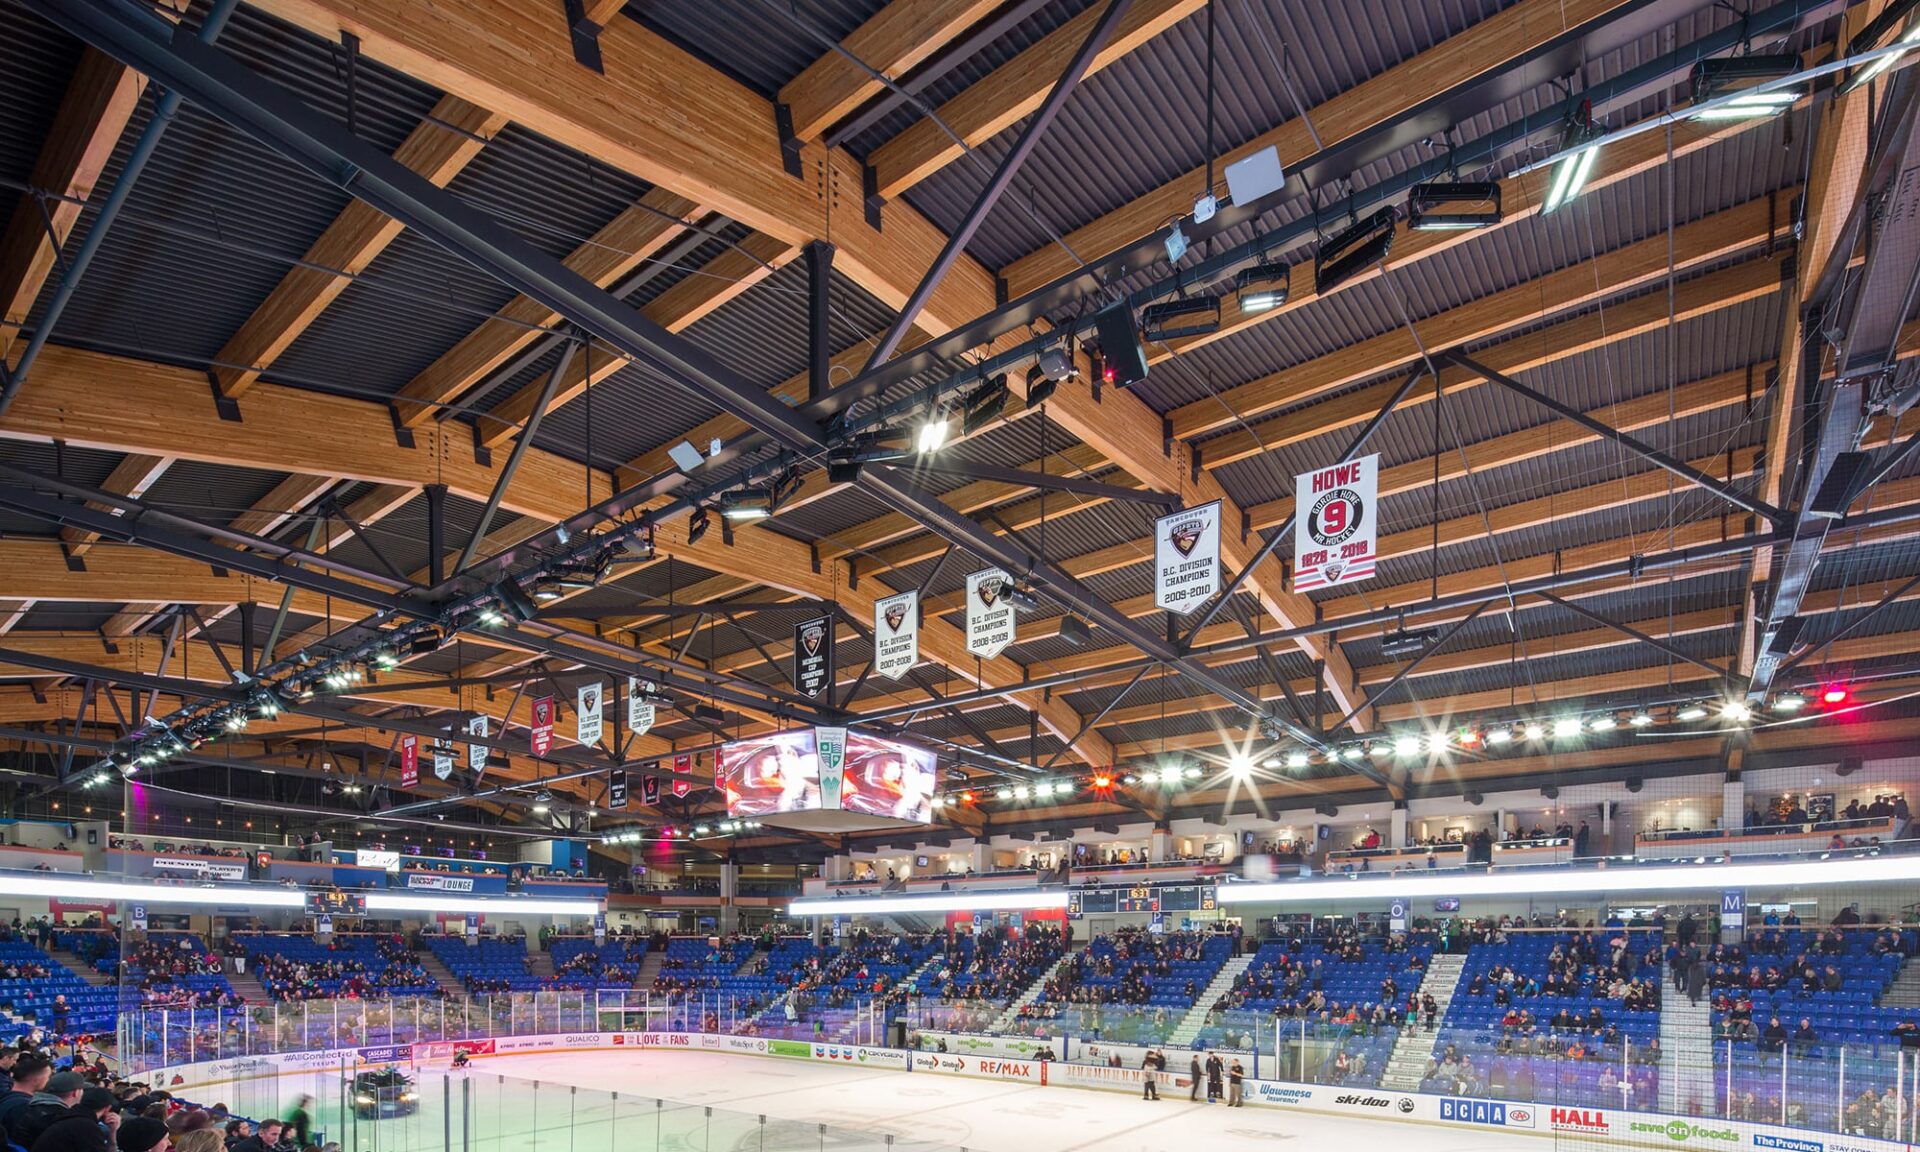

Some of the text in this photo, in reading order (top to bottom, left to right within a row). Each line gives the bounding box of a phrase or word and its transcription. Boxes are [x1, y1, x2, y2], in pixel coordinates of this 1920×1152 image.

[1313, 462, 1361, 493] HOWE
[1312, 492, 1360, 514] GORDIE HOWE
[1324, 500, 1346, 534] 9
[1326, 526, 1356, 546] HOCKEY
[1163, 557, 1213, 577] B.C. DIVISION
[1165, 569, 1210, 587] CHAMPIONS
[1165, 584, 1210, 603] 2009-2010
[985, 608, 1009, 621] DIVISION
[974, 619, 1007, 634] CHAMPIONS
[891, 634, 912, 646] DIVISION
[972, 632, 1008, 648] 2008-2009
[882, 643, 910, 656] CHAMPIONS
[880, 656, 912, 670] 2007-2008
[442, 880, 471, 890] LOUNGE
[1070, 904, 1079, 912] 21
[1152, 902, 1158, 911] 2
[1203, 901, 1214, 909] 20
[1724, 896, 1740, 910] M
[135, 907, 144, 917] B
[1154, 912, 1161, 922] P
[1392, 904, 1403, 917] O
[322, 914, 331, 922] A
[469, 917, 476, 925] T
[834, 919, 839, 927] S
[974, 914, 981, 924] Q
[637, 1034, 660, 1045] LOVE
[670, 1035, 689, 1045] FANS
[868, 1051, 904, 1059] OXYGEN
[917, 1058, 933, 1066] Global
[942, 1060, 959, 1068] Global
[980, 1061, 1030, 1076] RE/MAX
[1260, 1084, 1312, 1098] Wawanesa
[1266, 1094, 1299, 1104] Insurance
[1335, 1094, 1390, 1108] ski-doo
[1444, 1103, 1502, 1121] BCAA
[1551, 1108, 1609, 1128] HALL
[1630, 1122, 1739, 1142] save on foods
[1756, 1136, 1821, 1152] The Province
[1830, 1144, 1846, 1152] STAY
